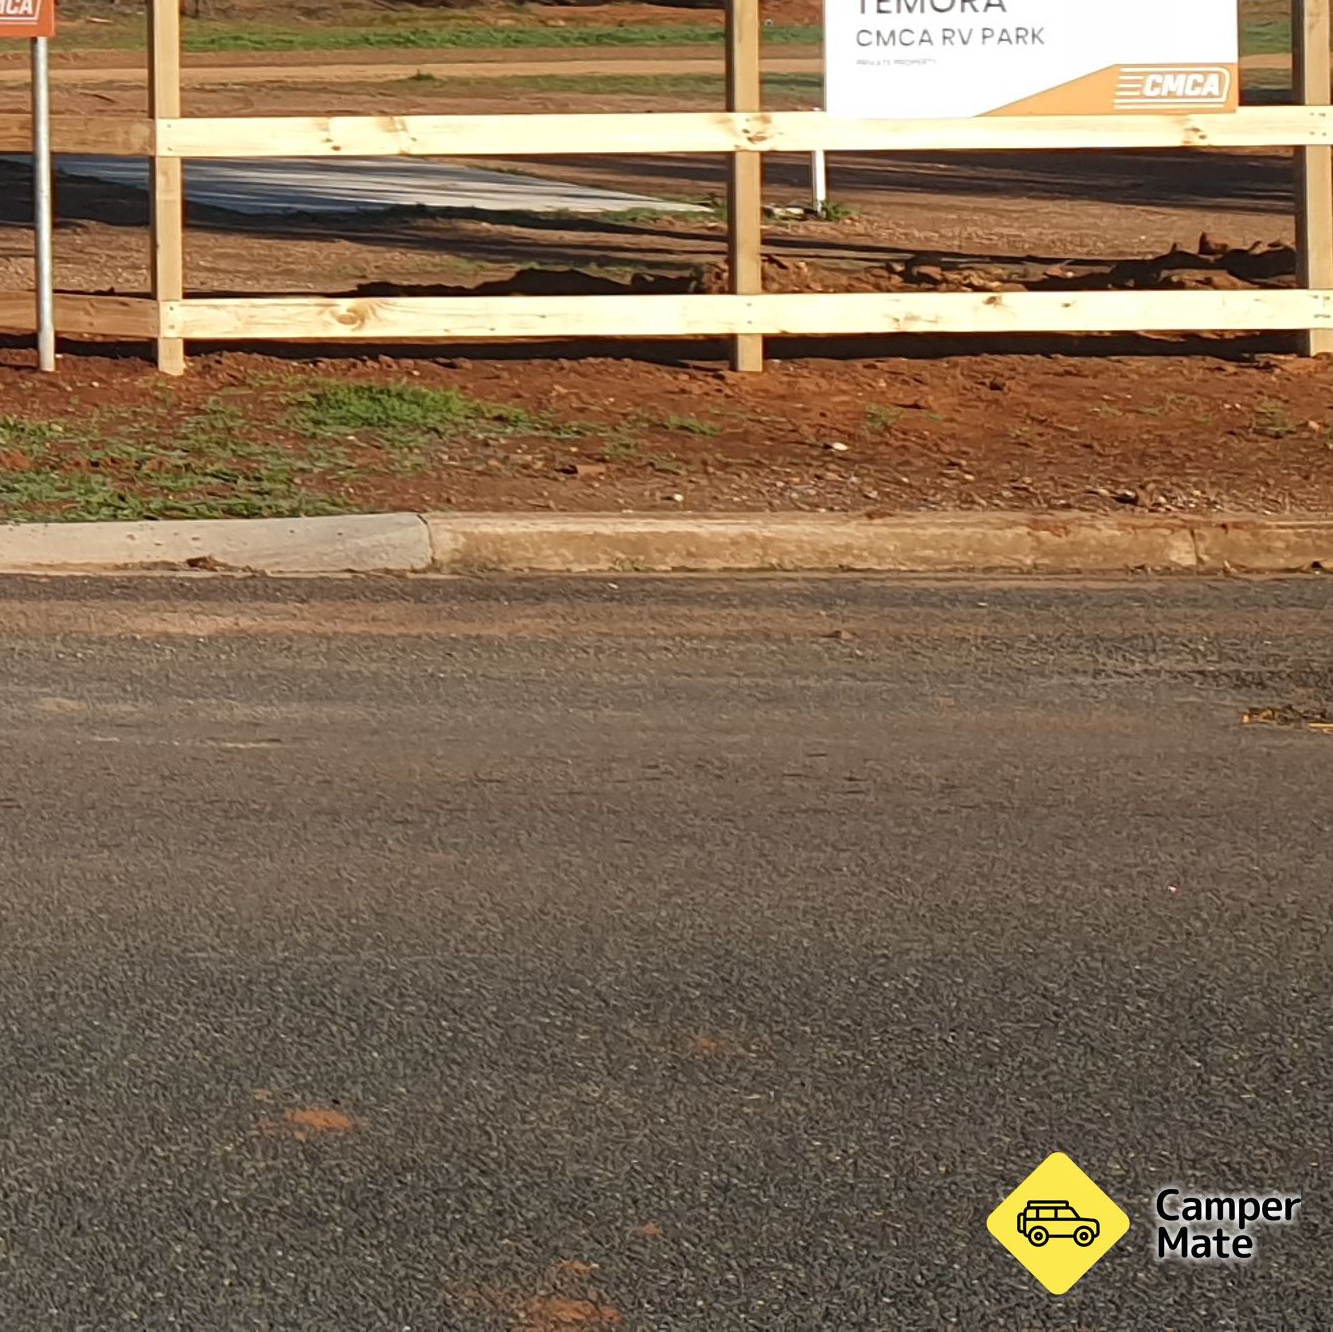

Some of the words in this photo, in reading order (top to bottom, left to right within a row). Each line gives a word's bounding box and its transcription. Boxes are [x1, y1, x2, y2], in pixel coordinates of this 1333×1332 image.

[855, 28, 934, 47] CMCA
[941, 27, 973, 46] RV
[982, 26, 1044, 46] PARK
[1142, 73, 1221, 97] CMCA
